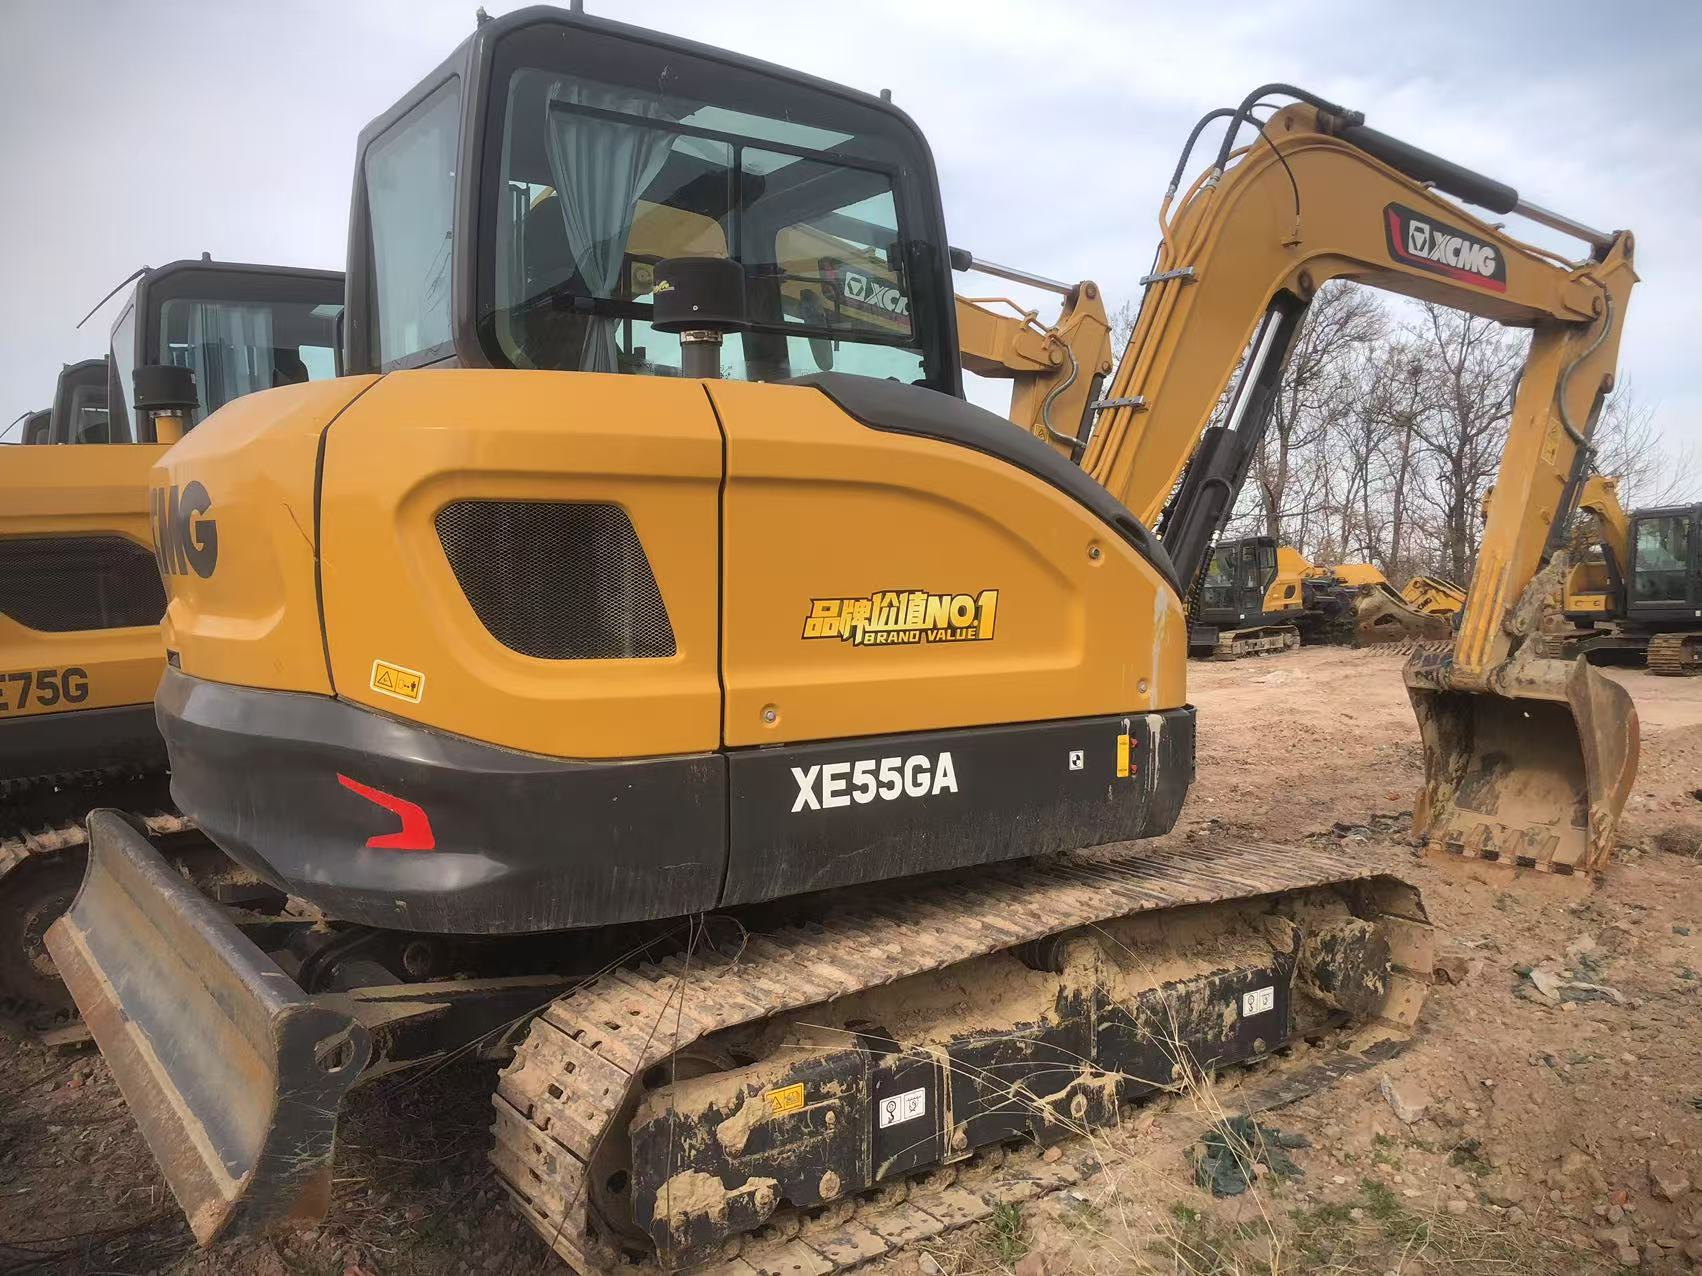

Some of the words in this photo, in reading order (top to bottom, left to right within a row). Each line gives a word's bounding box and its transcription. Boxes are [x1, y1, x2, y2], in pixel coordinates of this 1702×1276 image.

[1427, 230, 1497, 277] XCMG
[863, 631, 921, 645] BRAND
[927, 627, 977, 642] VALUE
[790, 751, 959, 813] XE55GA
